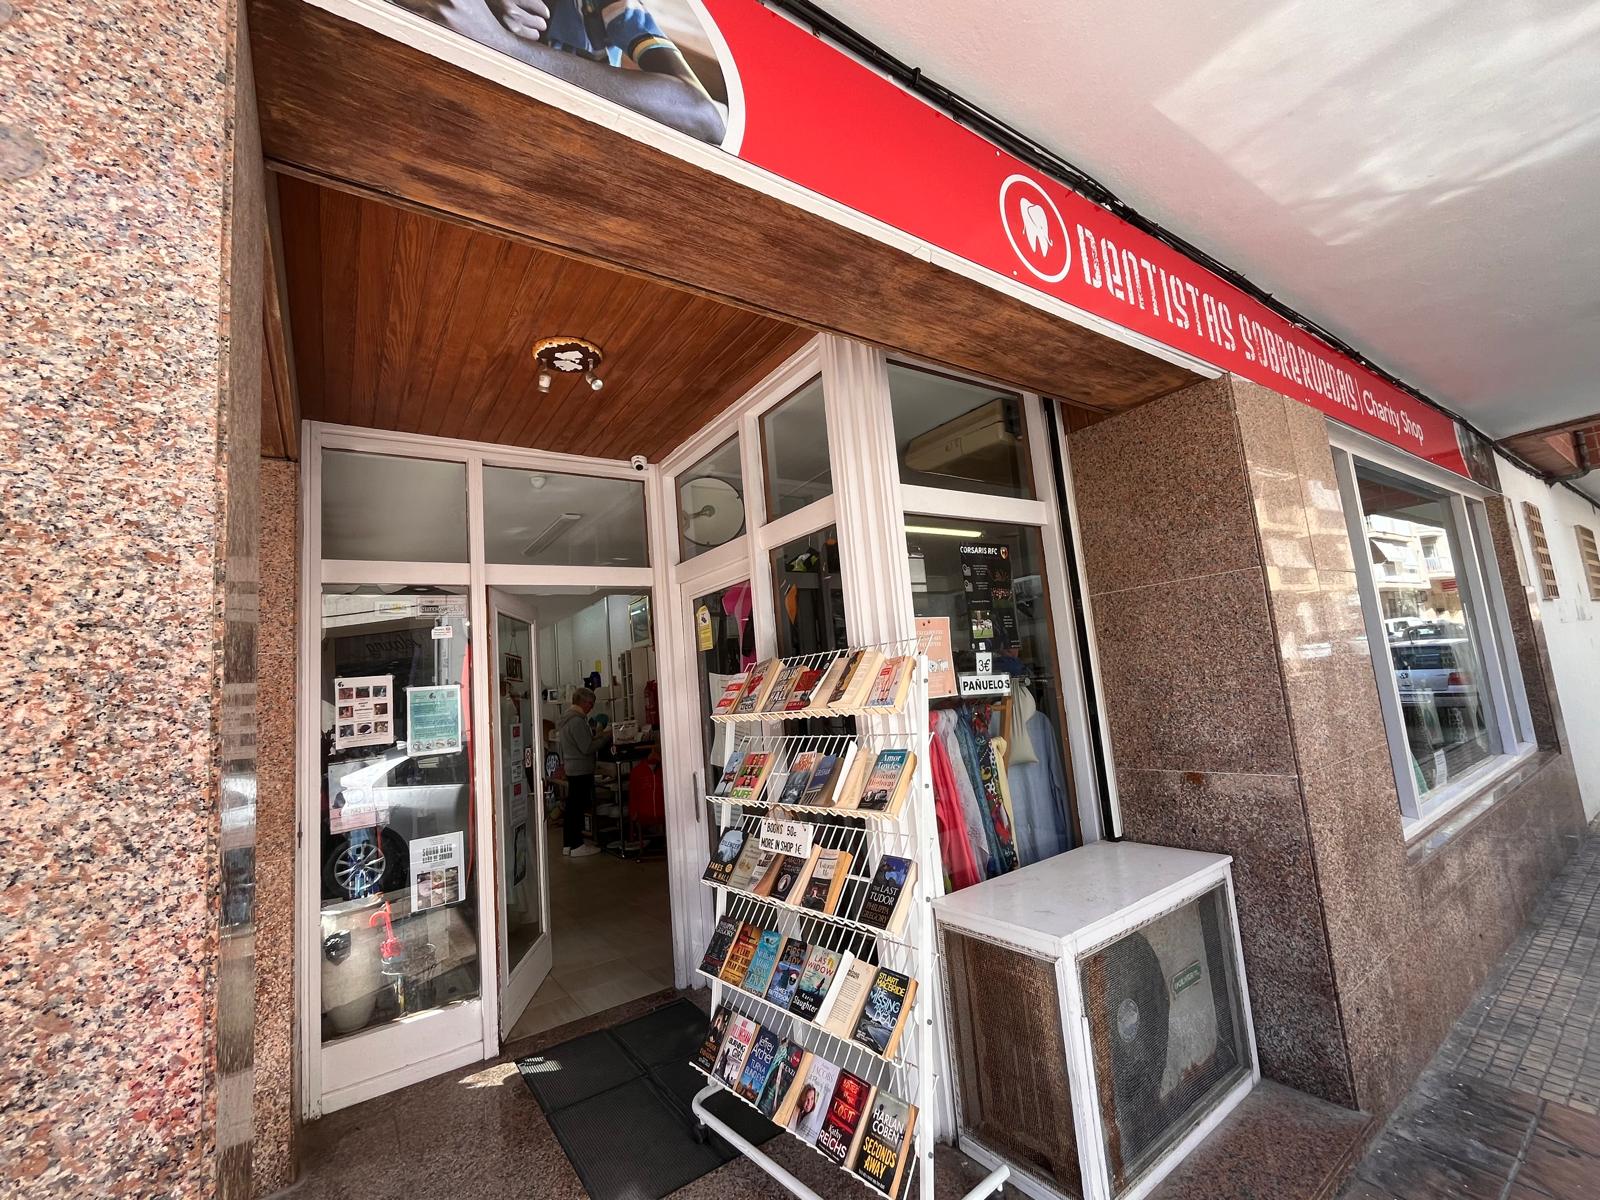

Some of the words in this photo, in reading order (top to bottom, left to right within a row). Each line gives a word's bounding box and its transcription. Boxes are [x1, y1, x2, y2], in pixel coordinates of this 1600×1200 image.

[1363, 390, 1400, 435] Charity
[1400, 409, 1424, 446] Shop
[960, 546, 987, 555] CORSARIS
[988, 547, 998, 555] RFC
[979, 659, 990, 672] 3€
[962, 678, 1010, 691] PAÑUELOS
[877, 761, 901, 770] Towles
[884, 754, 902, 762] Amor
[766, 822, 783, 834] BOOKS
[761, 837, 774, 849] MORE
[774, 839, 780, 850] IN
[780, 840, 794, 852] SHOP
[869, 891, 896, 906] TUDOR
[879, 884, 899, 896] LAST
[807, 961, 834, 976] WIDOW
[879, 972, 899, 986] STUART
[876, 979, 906, 997] MACBRIDE
[793, 995, 818, 1013] Slaughter
[801, 993, 814, 1002] Karin
[870, 990, 901, 1013] MISSING
[874, 1010, 897, 1029] DEAD
[760, 1036, 774, 1053] Jeffrey
[751, 1043, 774, 1064] Archer
[834, 1101, 856, 1123] LOST
[873, 1108, 905, 1134] HARLAN
[828, 1124, 842, 1142] Kathy
[872, 1120, 899, 1146] COBEN
[819, 1129, 847, 1158] REICHS
[863, 1136, 897, 1168] SECONDS
[864, 1155, 886, 1179] AWAY
